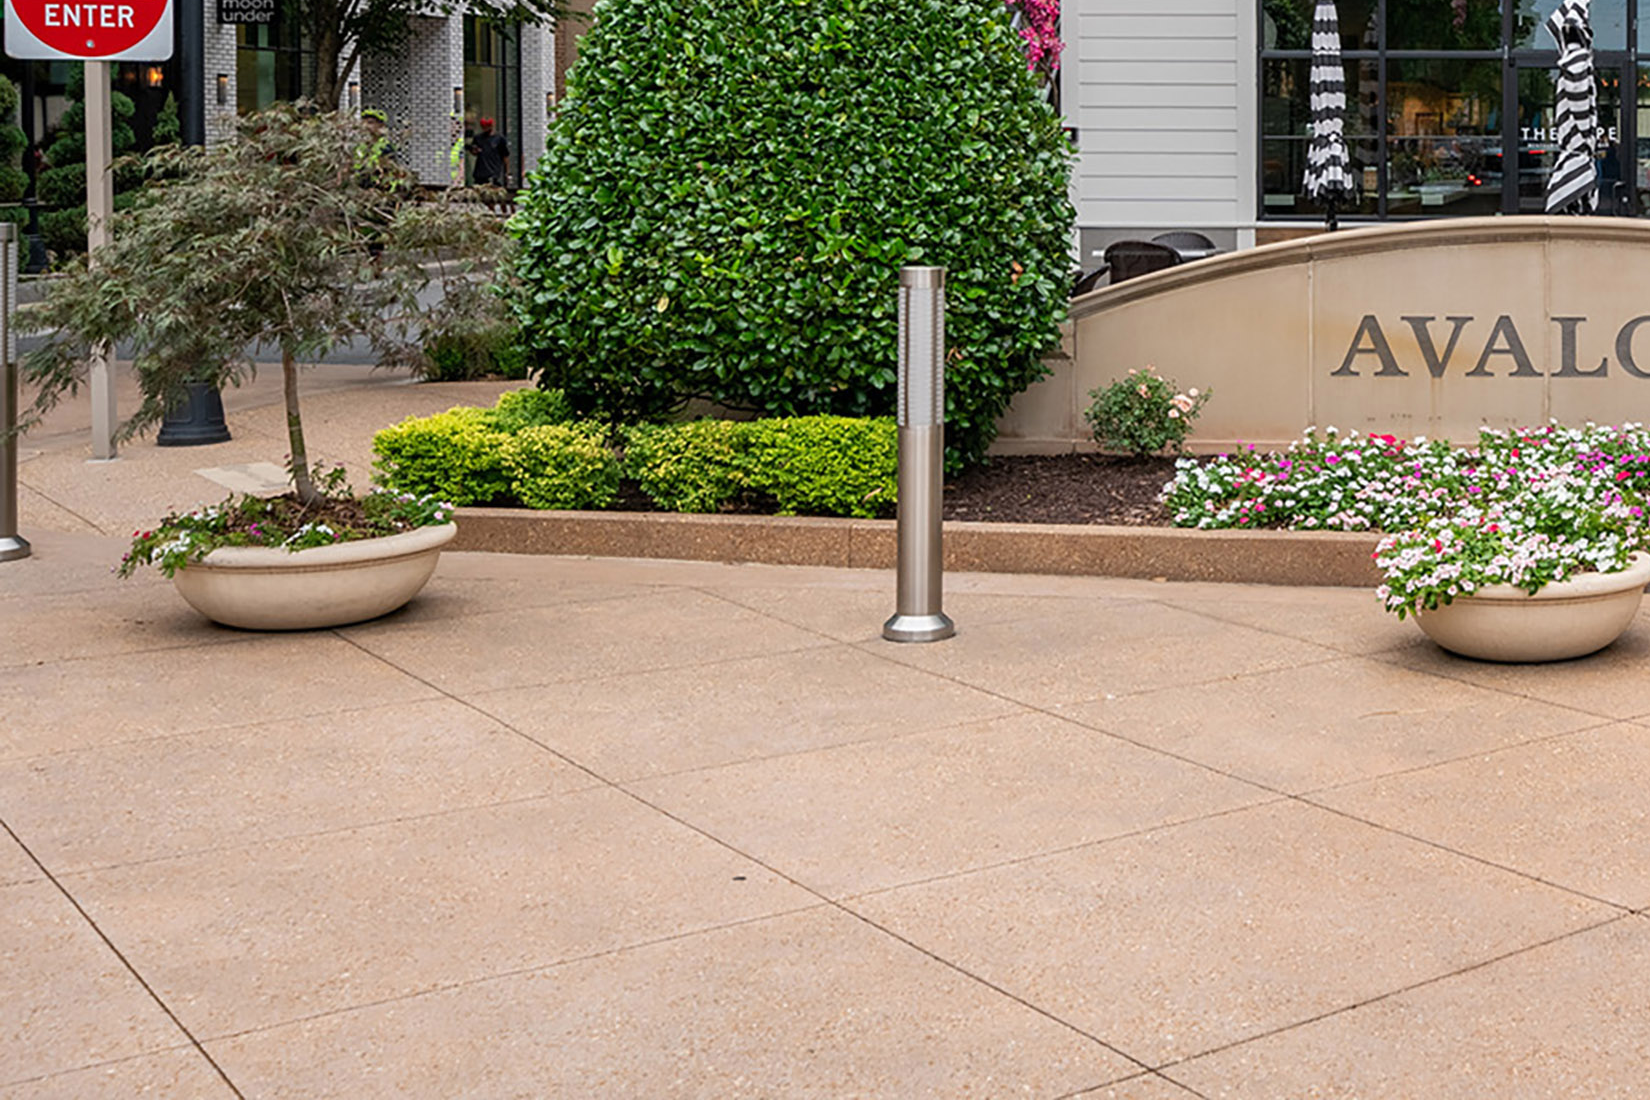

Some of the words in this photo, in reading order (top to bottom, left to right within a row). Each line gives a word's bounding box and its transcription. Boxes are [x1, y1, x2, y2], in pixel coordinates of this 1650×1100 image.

[44, 3, 135, 28] ENTER
[222, 10, 275, 22] under
[1520, 127, 1558, 141] THE
